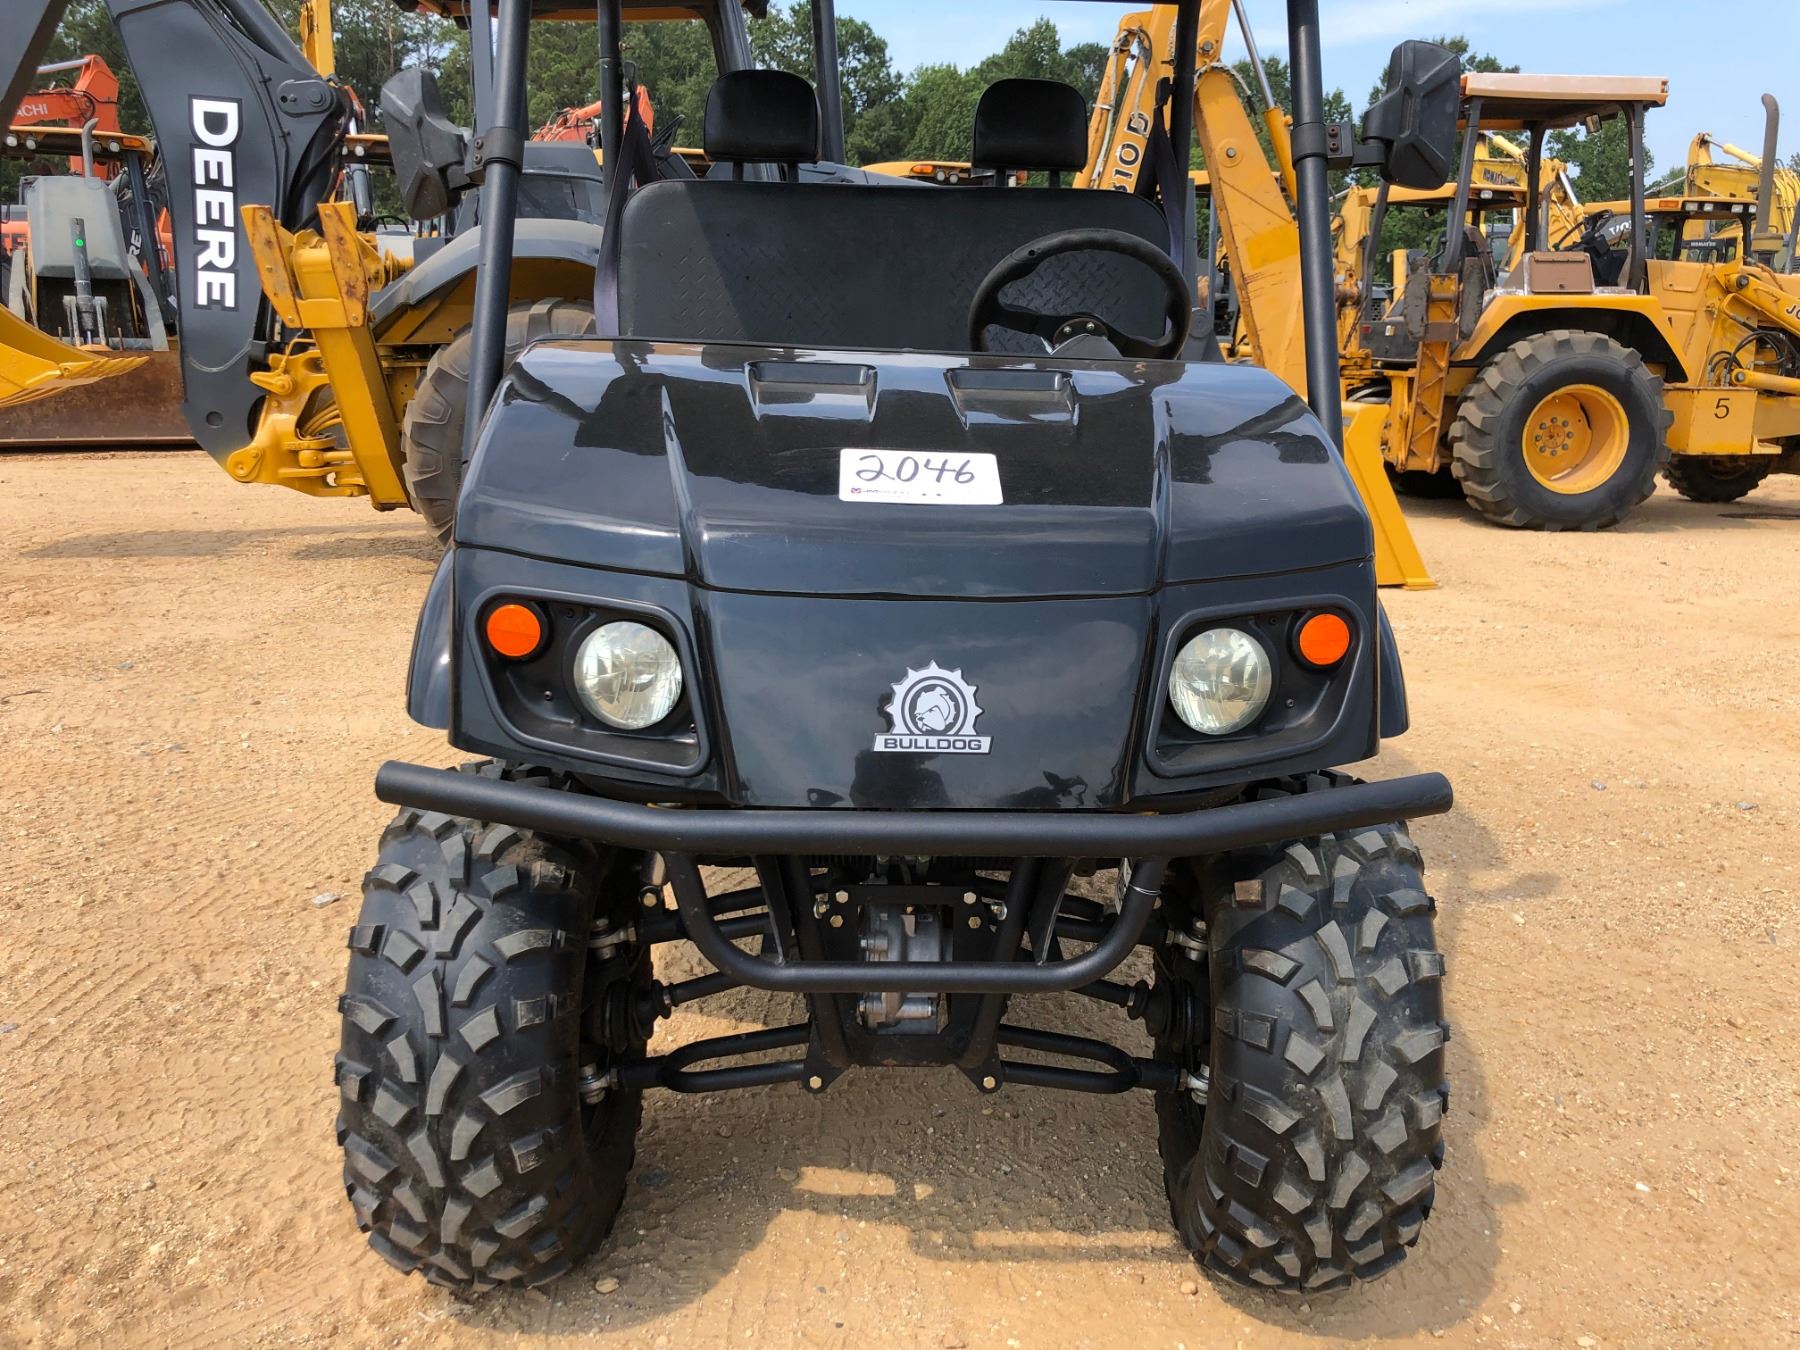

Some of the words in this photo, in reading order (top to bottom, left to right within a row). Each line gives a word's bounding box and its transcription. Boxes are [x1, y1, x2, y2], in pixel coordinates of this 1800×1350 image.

[192, 98, 239, 308] DEERE
[1713, 397, 1731, 419] 5
[855, 454, 975, 484] 2046
[883, 737, 982, 751] BULLDOG
